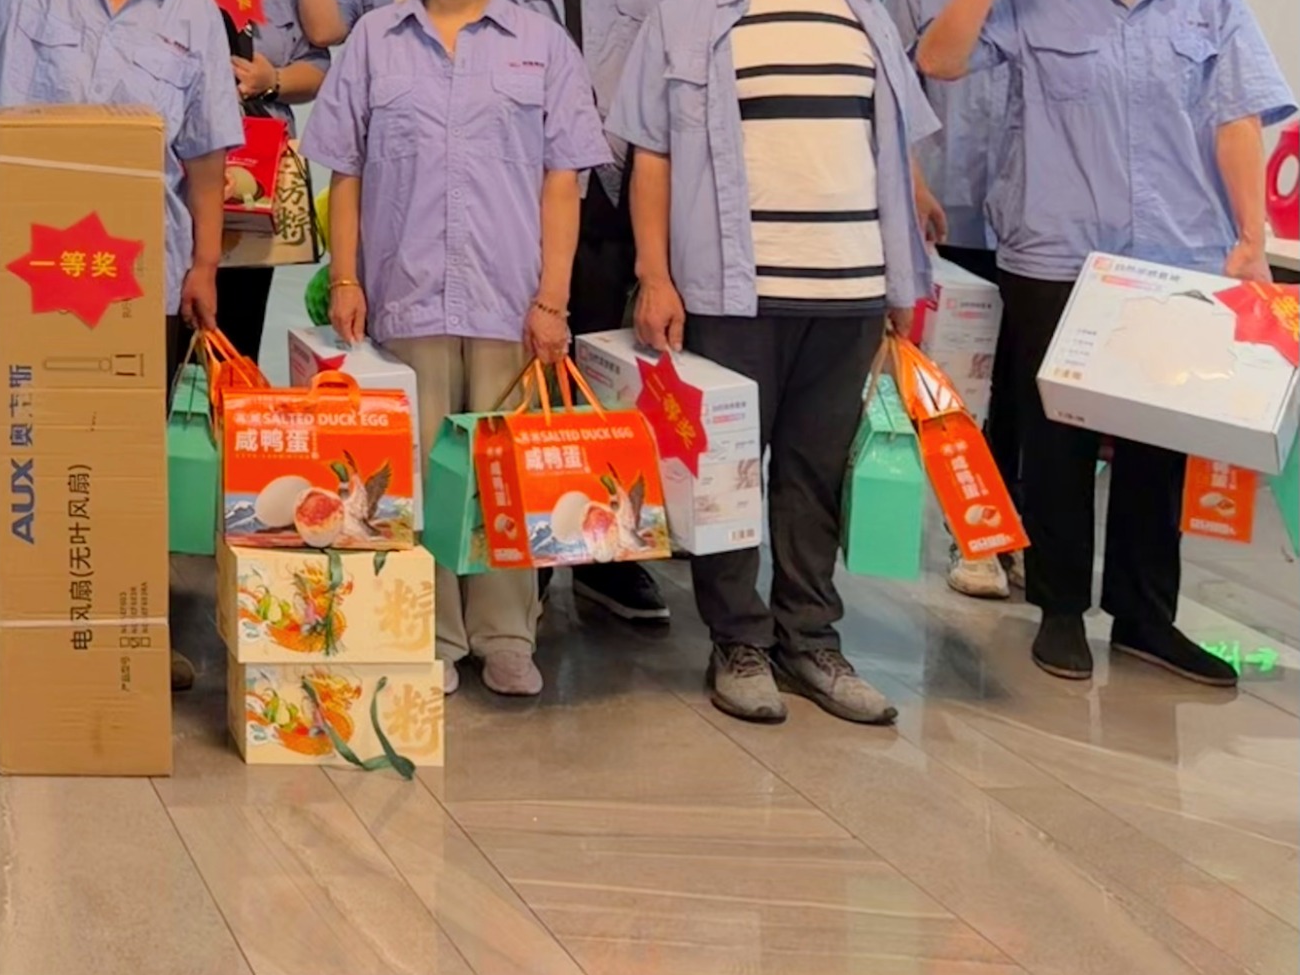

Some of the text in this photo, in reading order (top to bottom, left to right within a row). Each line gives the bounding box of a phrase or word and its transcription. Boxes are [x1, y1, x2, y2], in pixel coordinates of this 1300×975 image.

[29, 251, 117, 279] 一等奖
[262, 413, 389, 426] SALTED DUCK EGG
[235, 428, 310, 453] 咸鸭蛋
[540, 426, 634, 443] SALTED DUCK EGG
[524, 444, 583, 471] 咸鸭蛋
[11, 458, 35, 544] AUX
[68, 464, 93, 650] 电风扇(无叶风扇)
